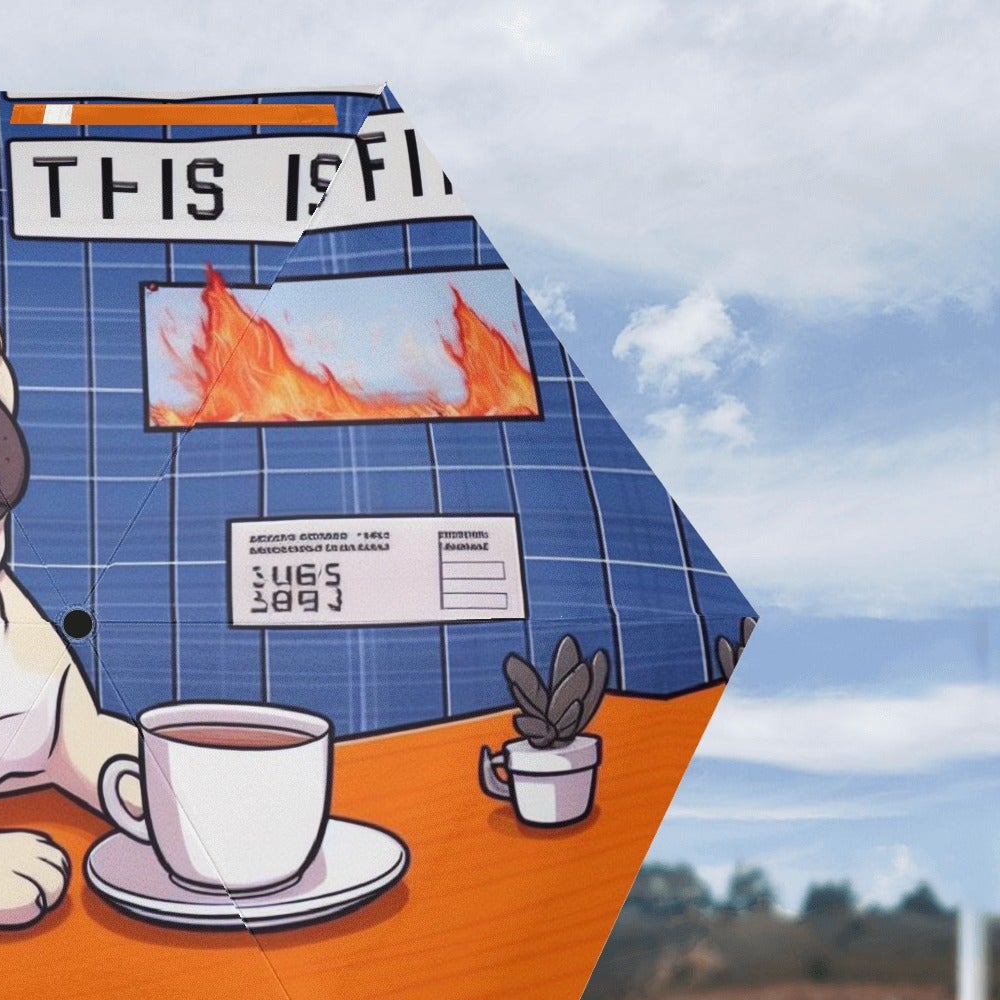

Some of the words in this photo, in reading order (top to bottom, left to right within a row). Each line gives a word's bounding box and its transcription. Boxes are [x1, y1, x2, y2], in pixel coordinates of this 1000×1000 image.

[33, 156, 224, 221] THIS
[286, 153, 342, 221] IS
[355, 128, 453, 202] FI
